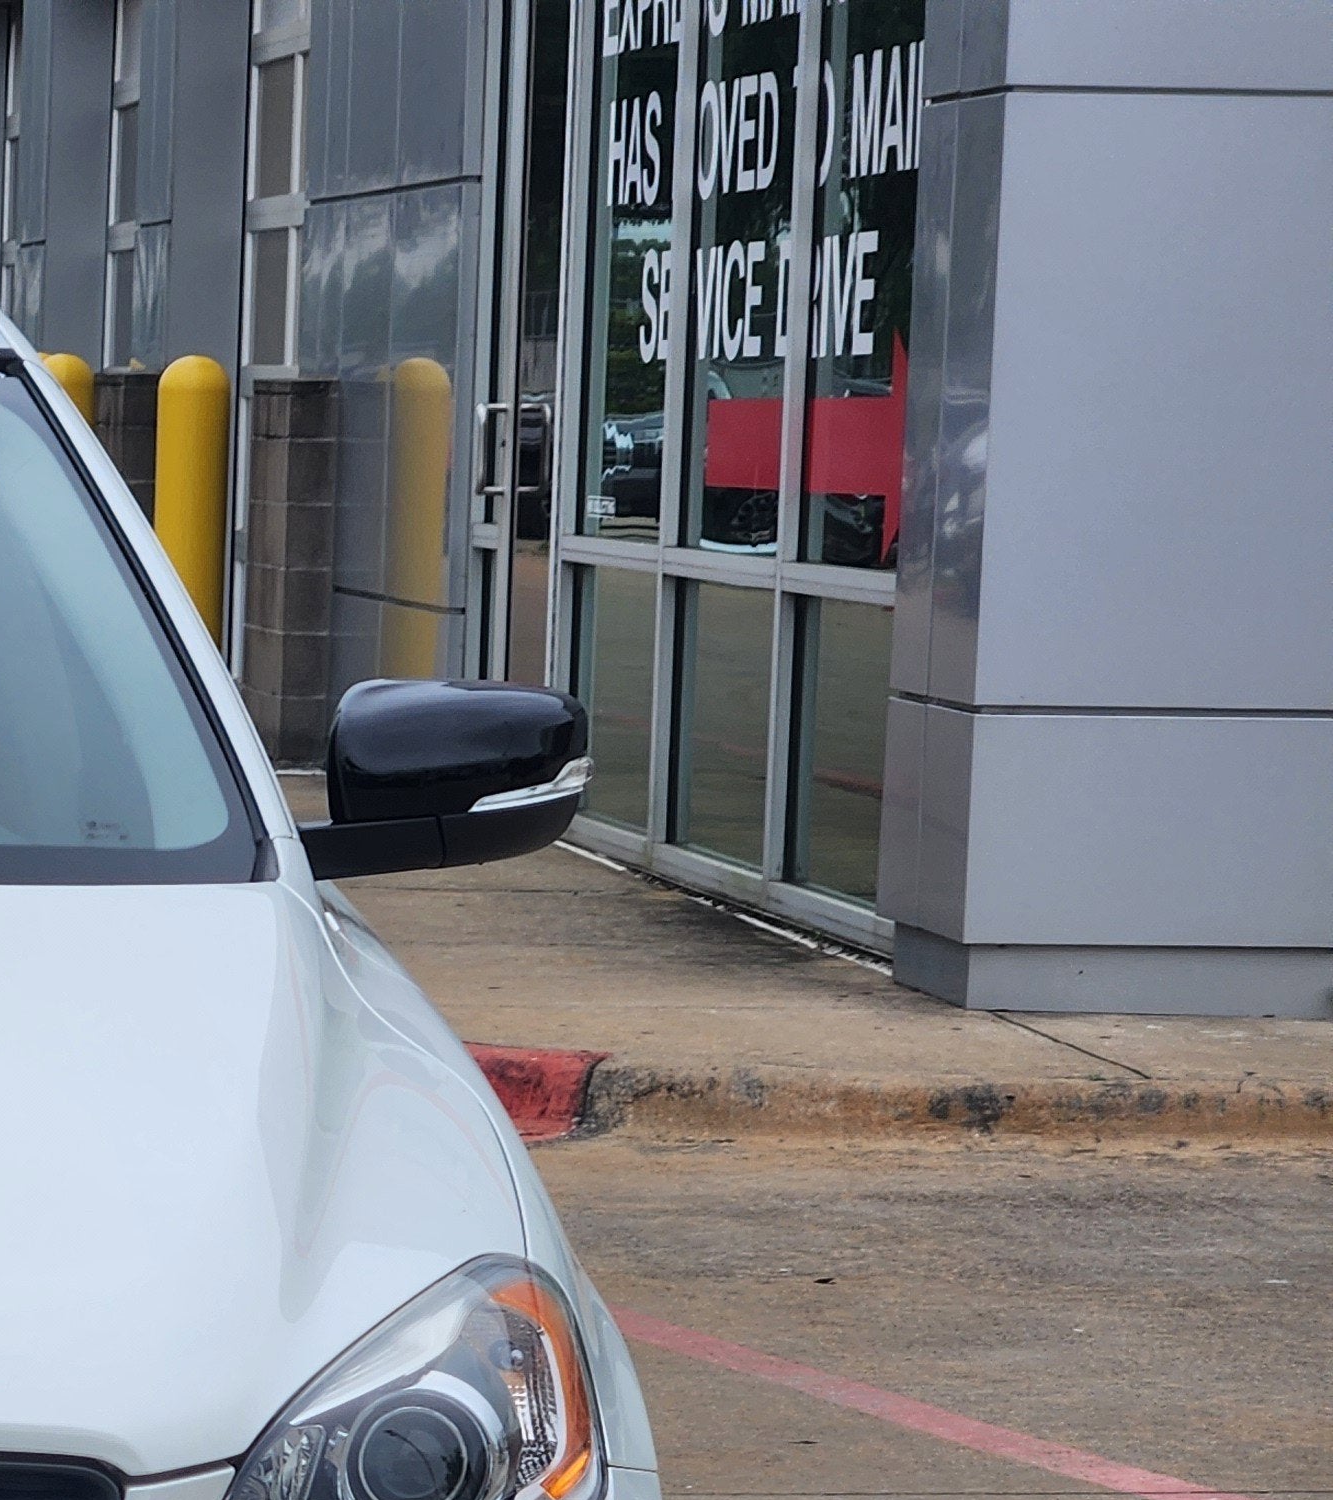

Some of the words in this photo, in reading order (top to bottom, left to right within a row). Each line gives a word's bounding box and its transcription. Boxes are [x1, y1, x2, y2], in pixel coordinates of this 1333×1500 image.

[607, 91, 662, 206] HAS
[697, 71, 779, 200] OVED
[850, 40, 925, 179] MAI
[639, 240, 766, 363] SEVICE
